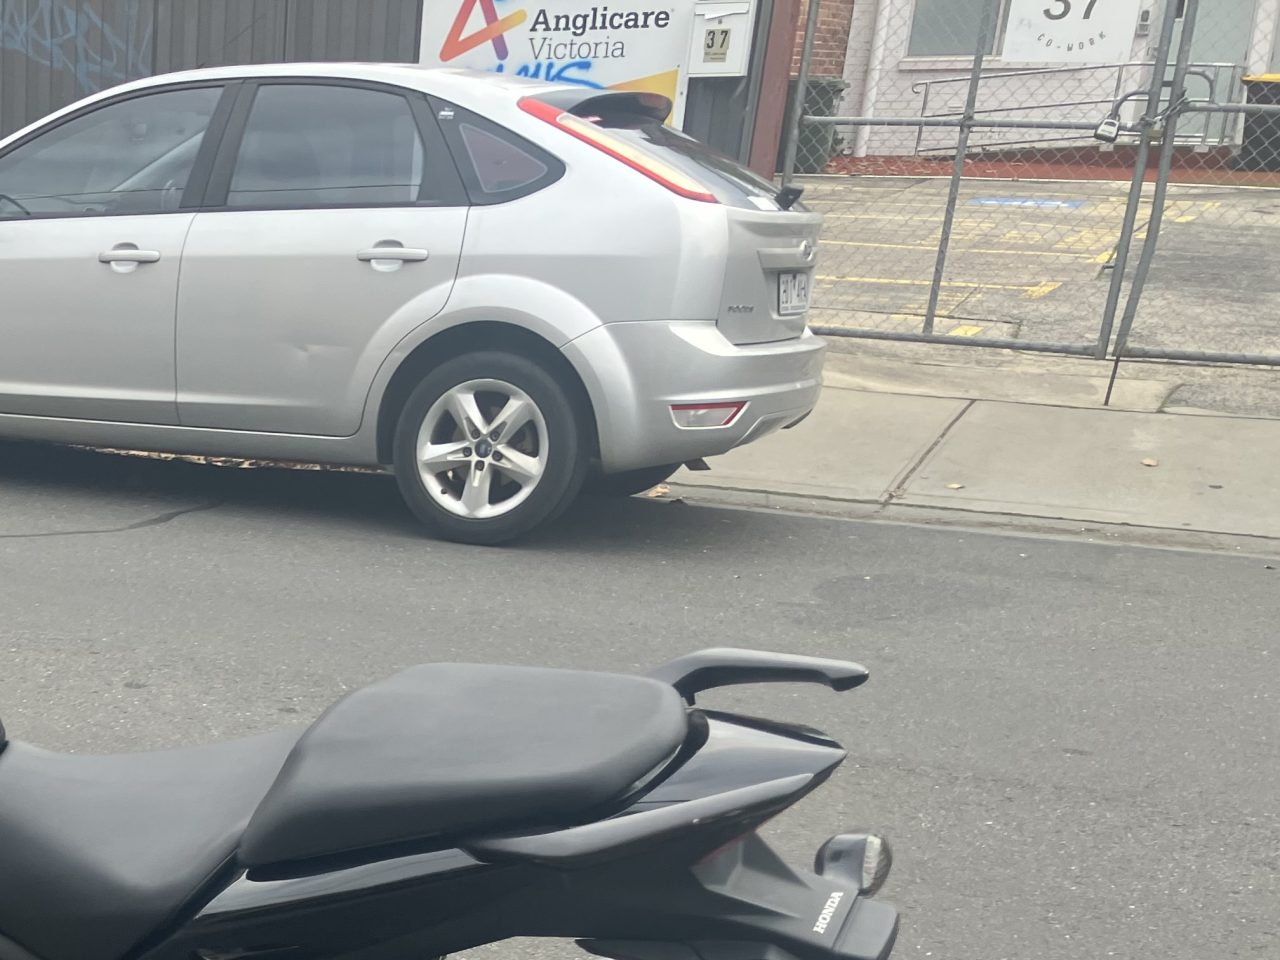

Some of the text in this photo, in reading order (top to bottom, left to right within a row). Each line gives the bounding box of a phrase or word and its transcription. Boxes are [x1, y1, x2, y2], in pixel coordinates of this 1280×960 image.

[529, 7, 670, 36] Anglicare
[529, 36, 626, 60] Victoria
[706, 30, 729, 49] 37
[813, 892, 844, 934] HONDA
